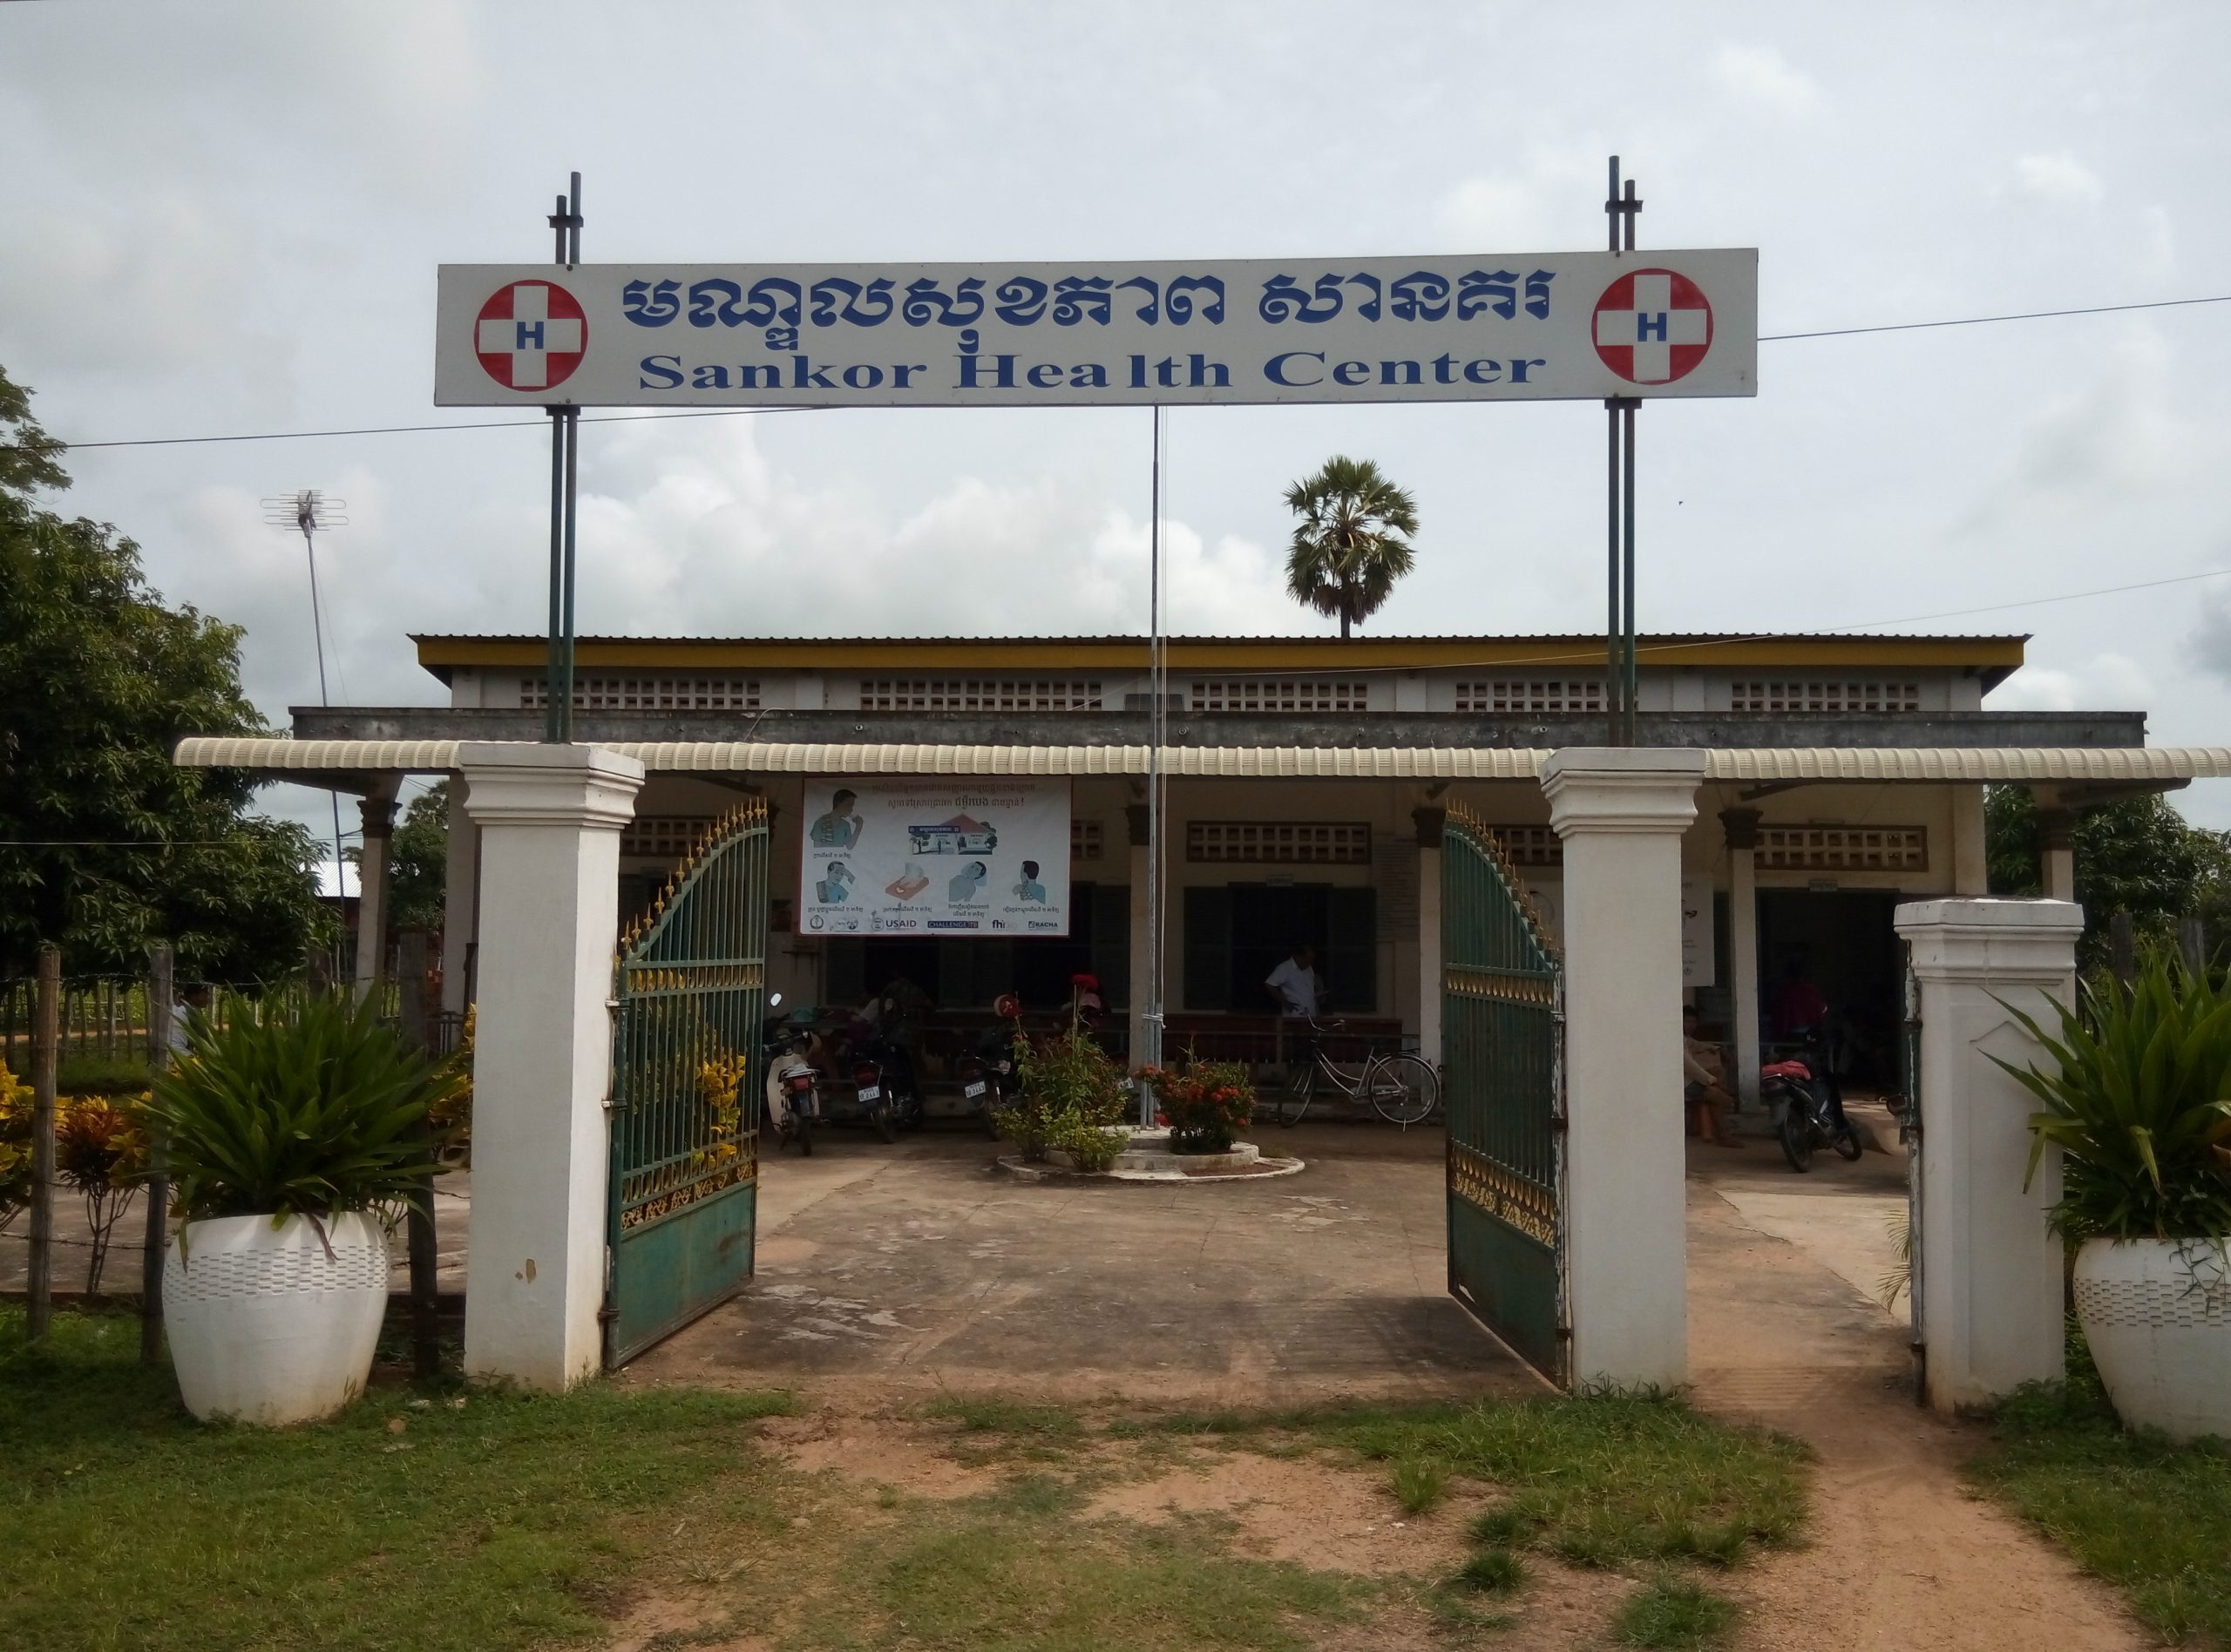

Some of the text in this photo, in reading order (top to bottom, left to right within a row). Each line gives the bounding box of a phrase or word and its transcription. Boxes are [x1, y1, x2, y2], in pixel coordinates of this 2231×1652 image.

[516, 322, 545, 349] H
[1637, 312, 1668, 342] H
[639, 350, 1548, 389] Sankor Health Center
[885, 919, 917, 928] USAID
